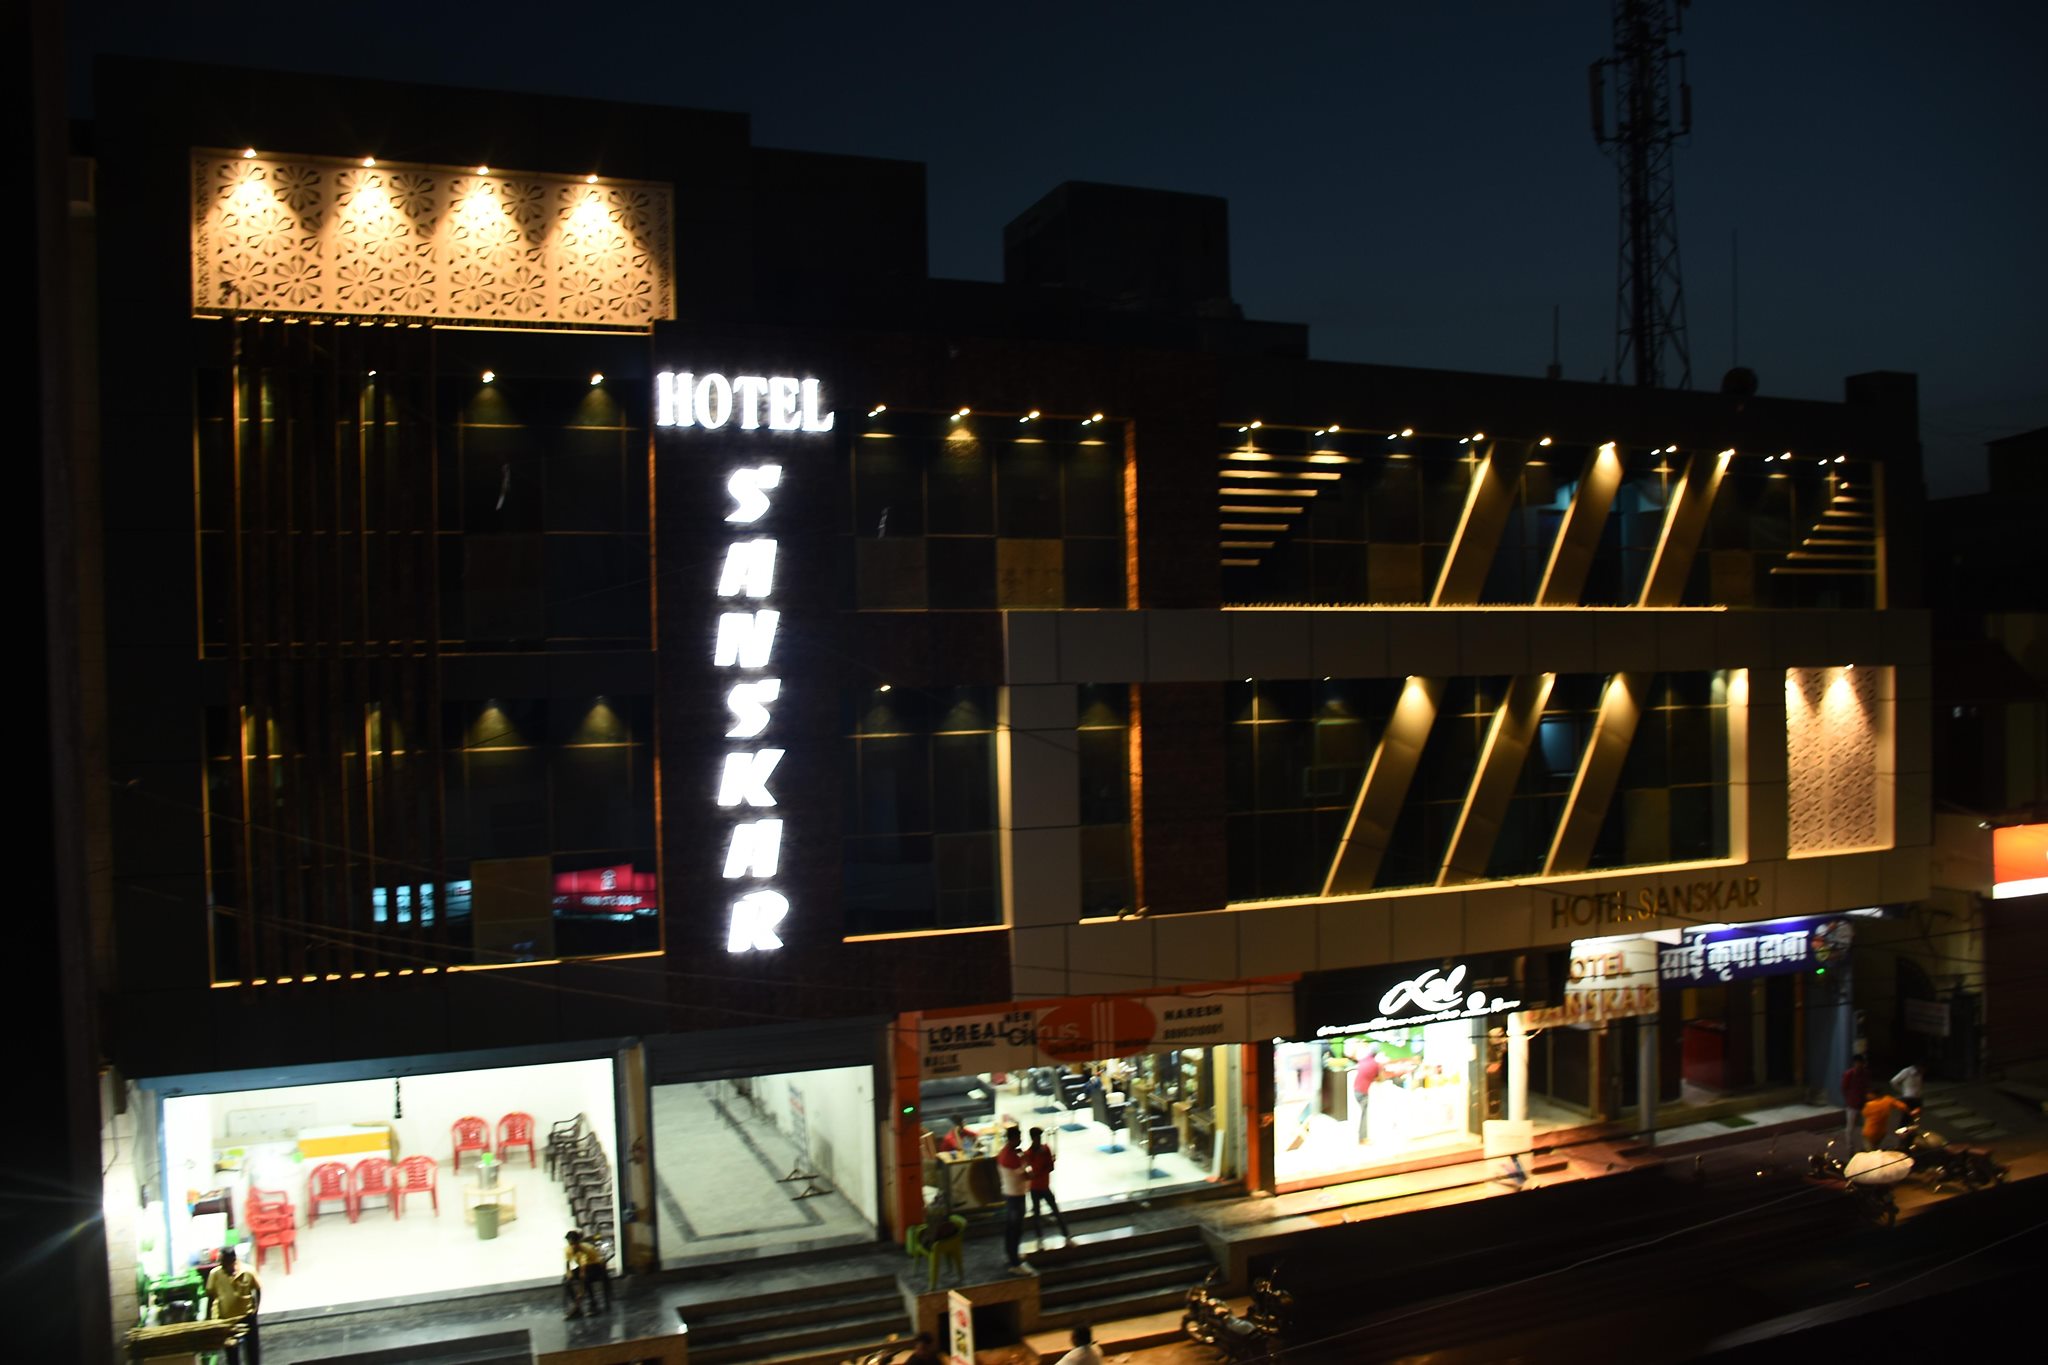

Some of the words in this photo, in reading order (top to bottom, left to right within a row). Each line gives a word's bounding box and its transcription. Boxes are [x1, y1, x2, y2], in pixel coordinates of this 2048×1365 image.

[656, 371, 834, 433] HOTEL
[714, 464, 789, 954] SANSKAR
[1551, 888, 1633, 929] HOTEL
[1638, 876, 1763, 921] SANSKAR
[1570, 952, 1633, 985] OTEL
